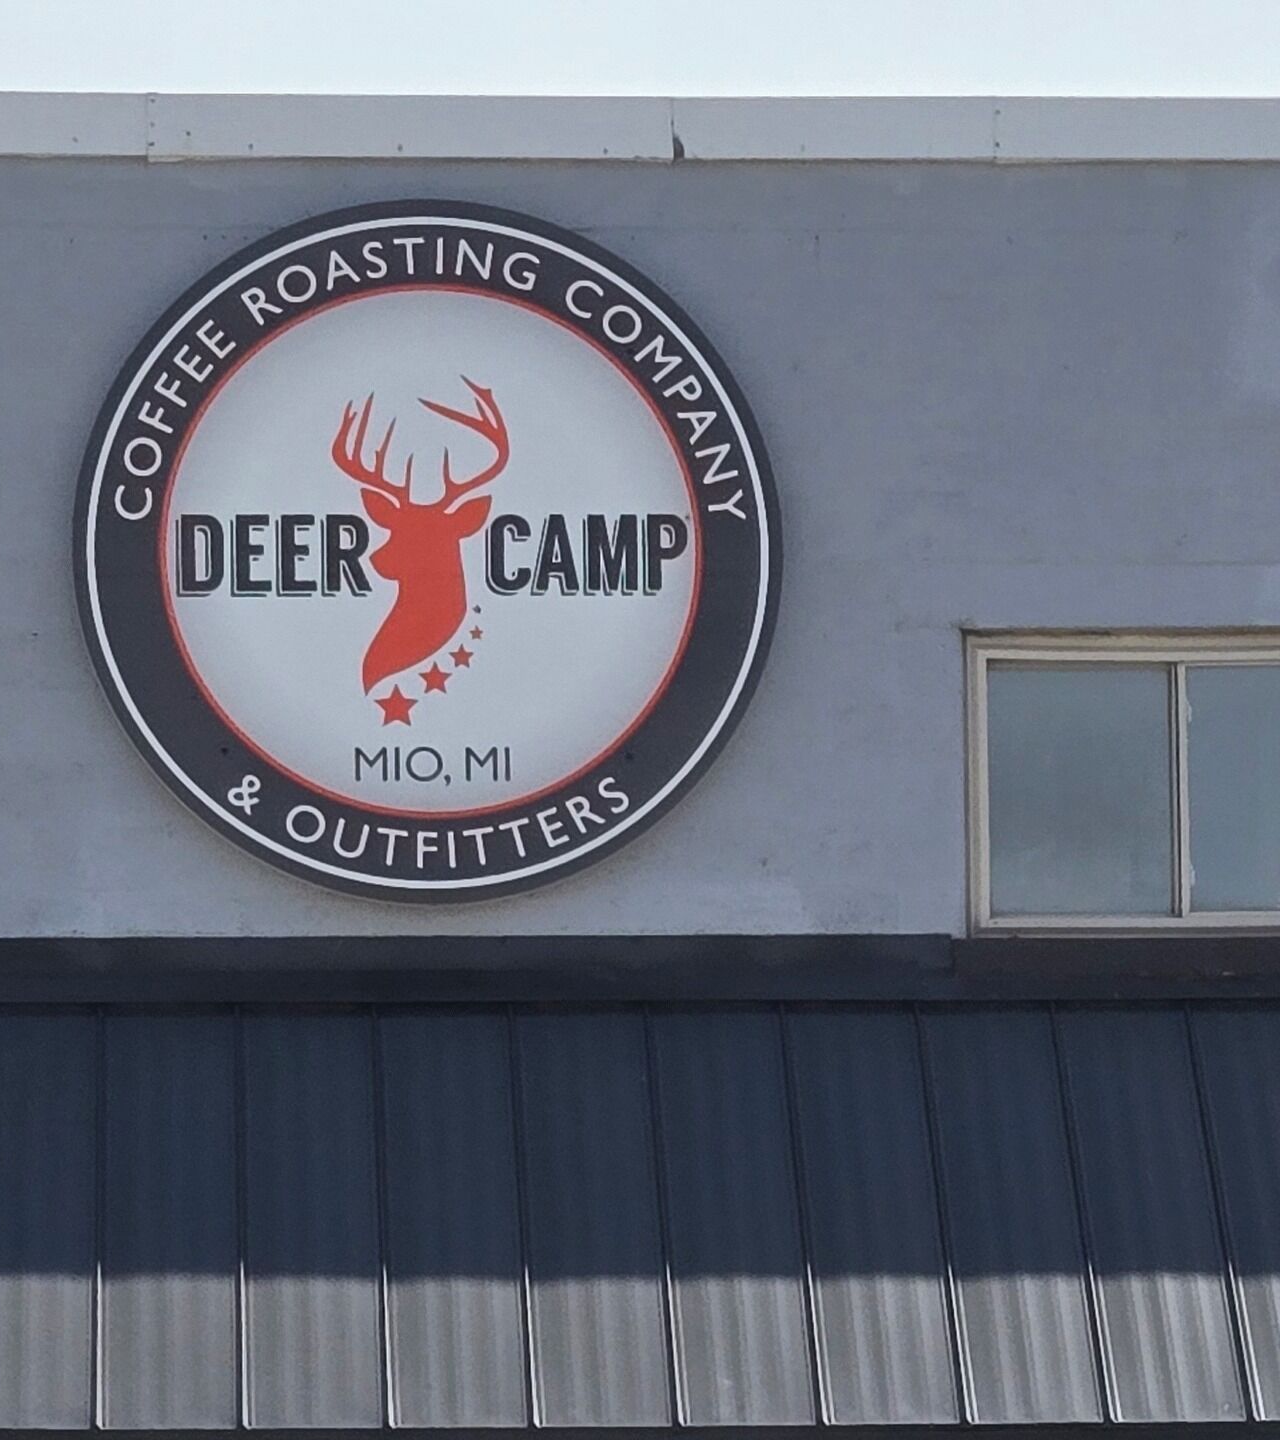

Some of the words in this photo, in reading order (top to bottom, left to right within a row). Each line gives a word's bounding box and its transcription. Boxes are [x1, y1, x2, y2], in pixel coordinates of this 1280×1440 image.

[114, 319, 236, 521] COFFEE
[240, 236, 541, 326] ROASTING
[565, 279, 747, 520] COMPANY
[176, 513, 373, 597] DEER
[484, 513, 689, 597] CAMP
[355, 746, 451, 786] MIO,
[465, 746, 510, 782] MI
[228, 774, 260, 816] &
[285, 776, 630, 868] OUTFITTERS
